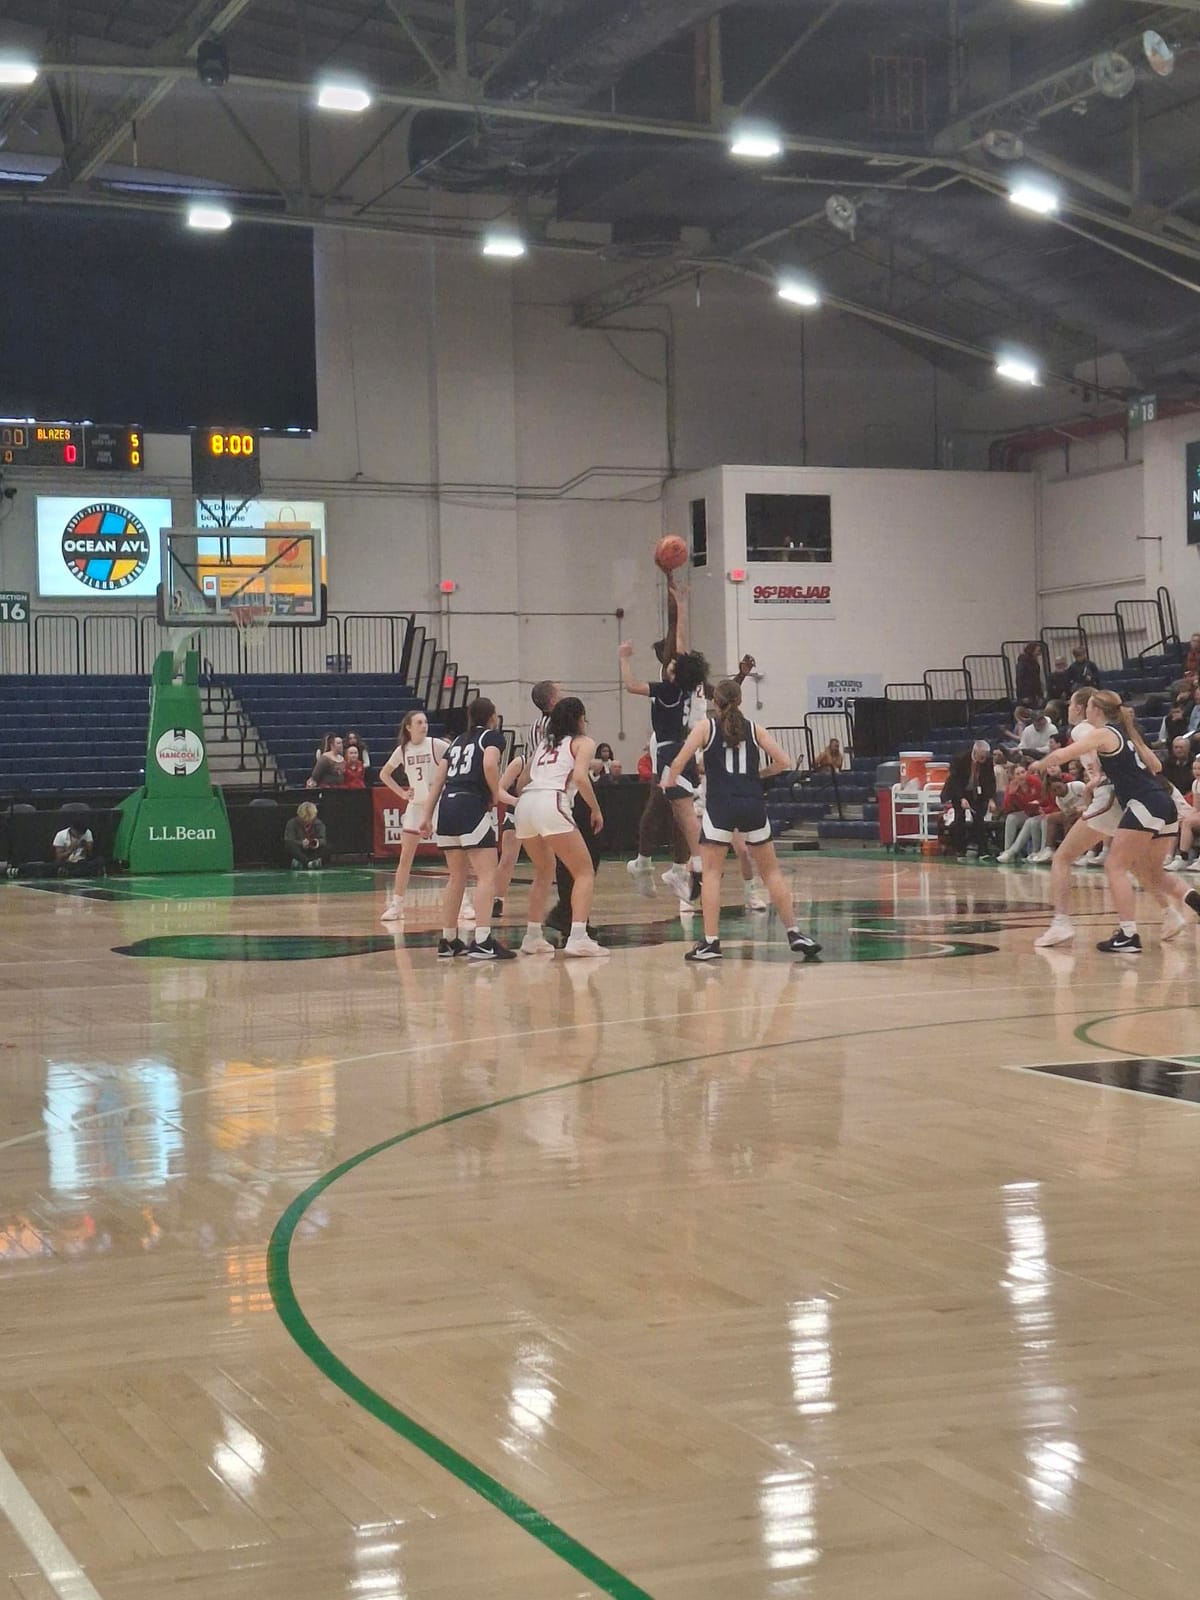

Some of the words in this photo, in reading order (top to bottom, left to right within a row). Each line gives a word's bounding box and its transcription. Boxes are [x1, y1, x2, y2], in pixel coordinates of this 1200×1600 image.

[37, 428, 71, 440] BLAZES
[211, 434, 254, 456] 8:00
[65, 444, 76, 463] 0
[131, 451, 141, 465] 0
[64, 540, 117, 552] OCEAN
[120, 540, 149, 552] AVL
[1, 603, 26, 620] 16
[816, 696, 843, 709] KID'S
[447, 743, 476, 777] 33
[415, 766, 423, 782] 3
[148, 826, 216, 841] L.L.Bean
